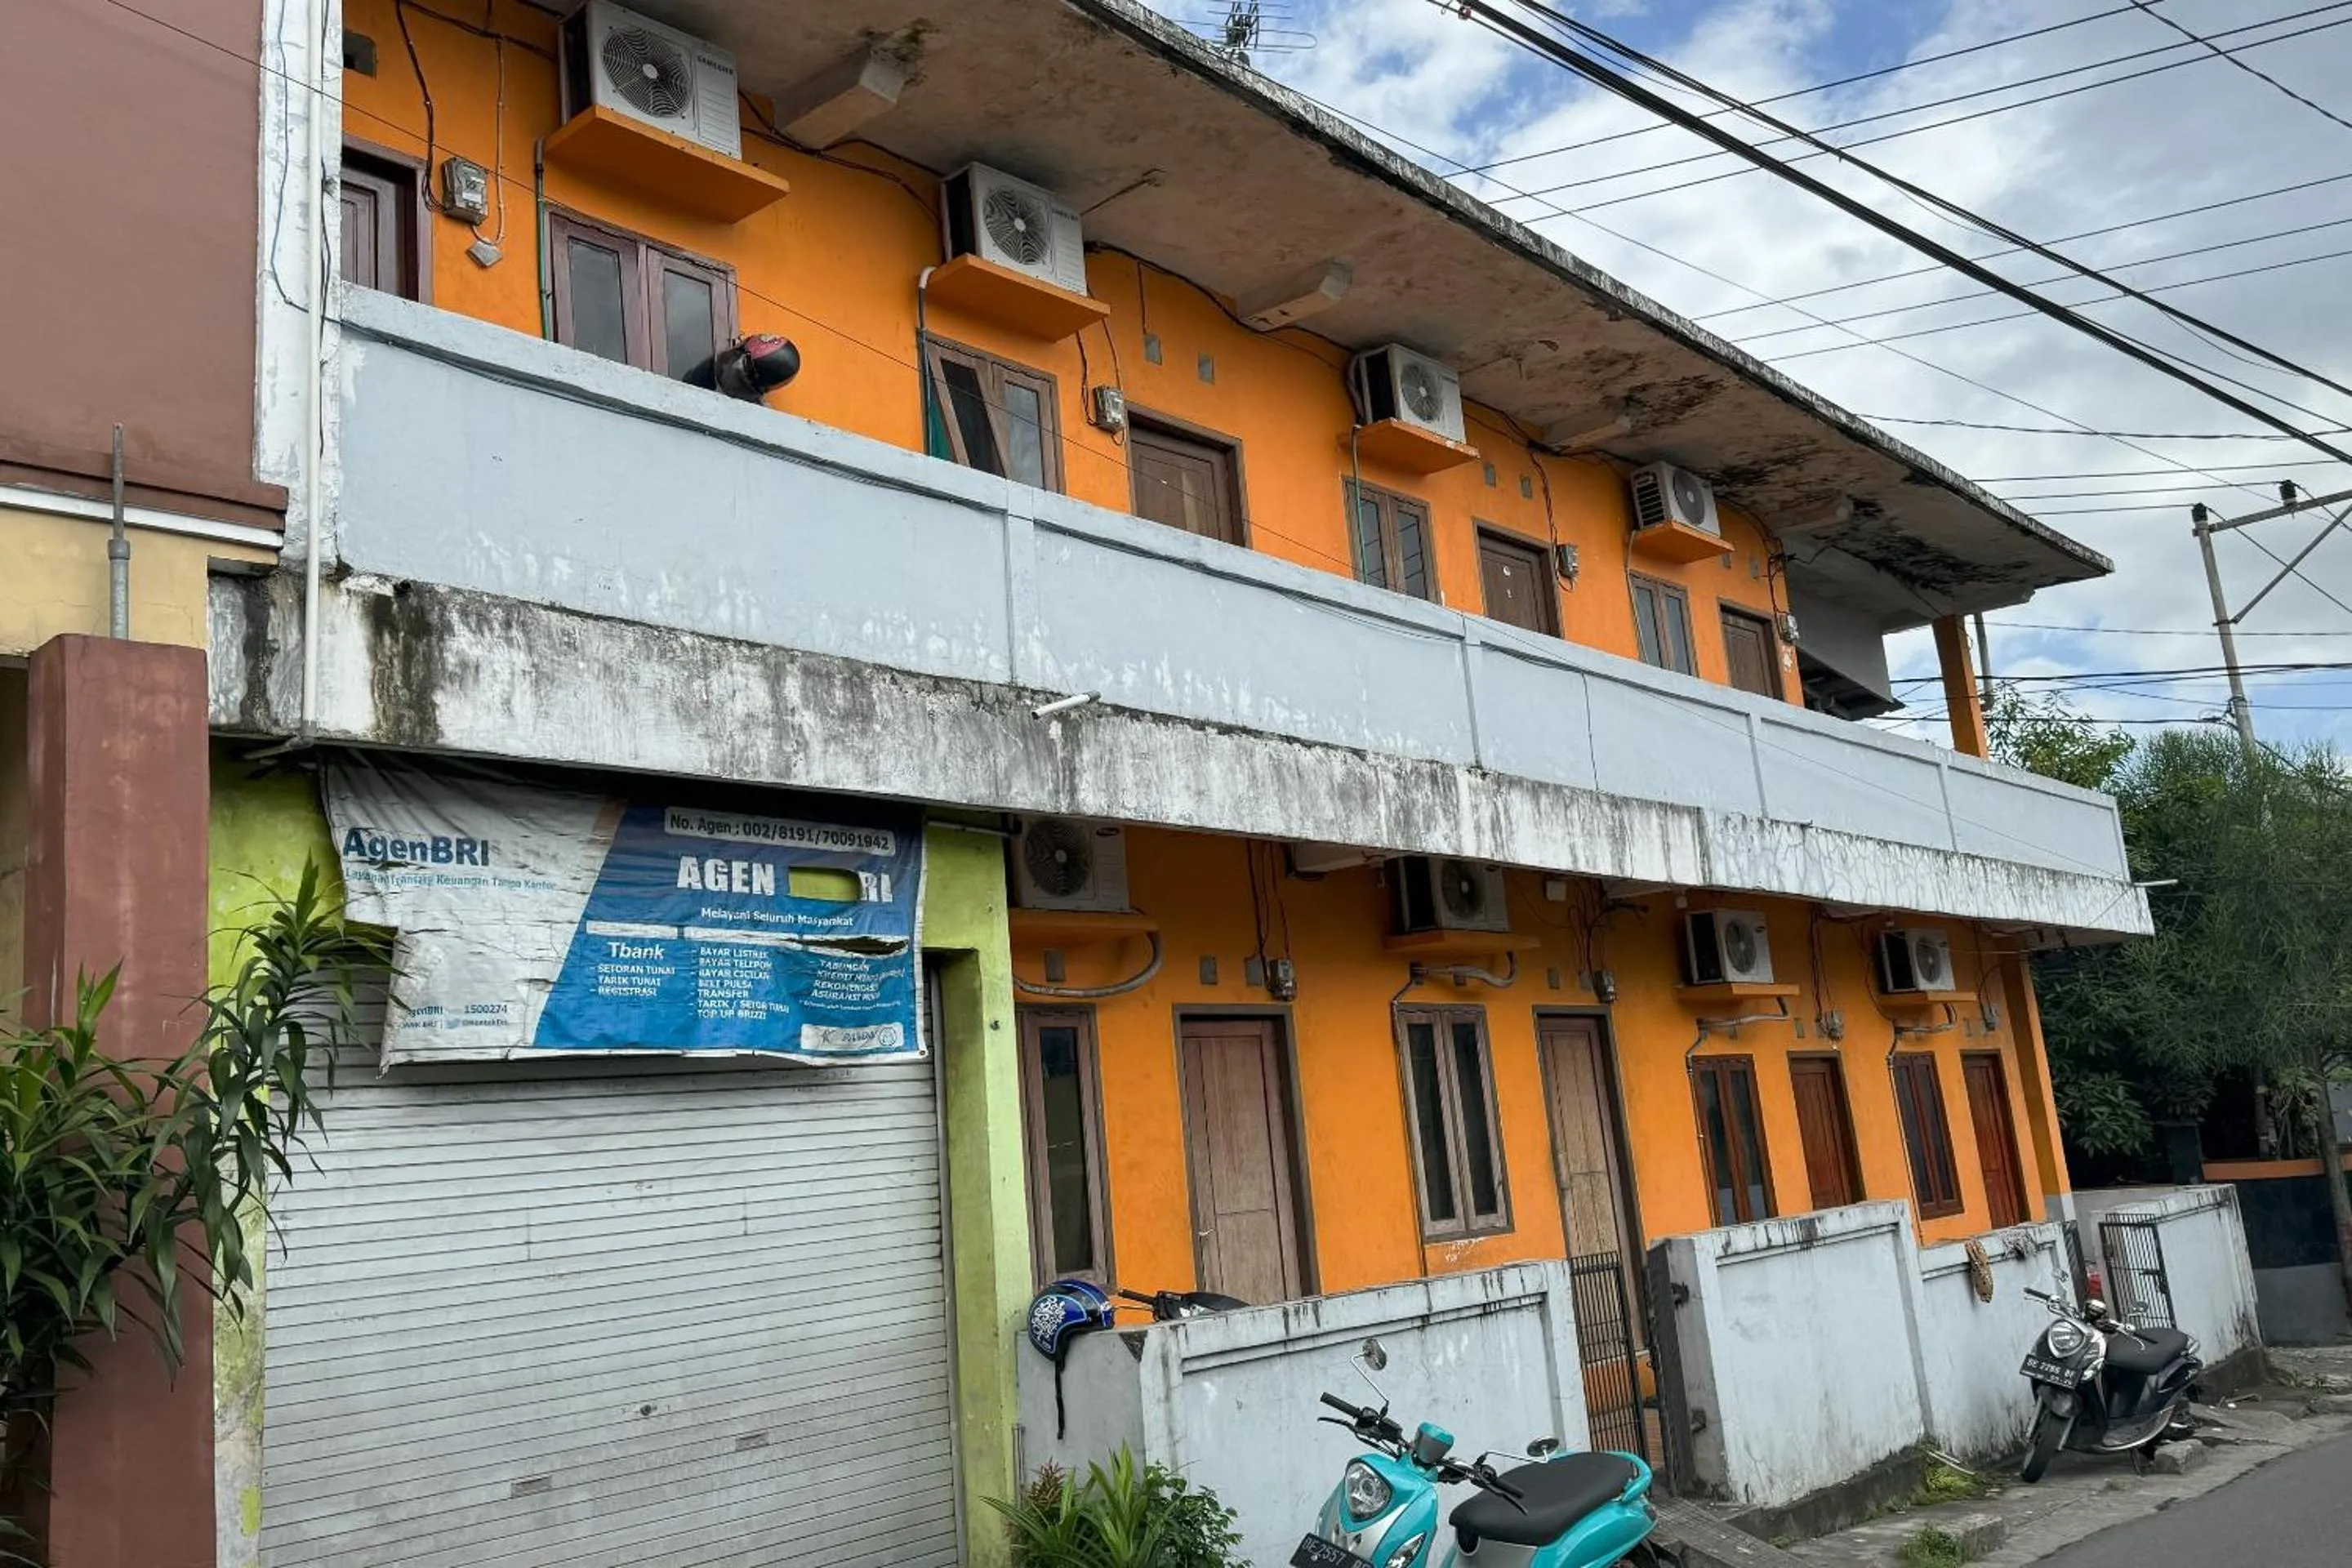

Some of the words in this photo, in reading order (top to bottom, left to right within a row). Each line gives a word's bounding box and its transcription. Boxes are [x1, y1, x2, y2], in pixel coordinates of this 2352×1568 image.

[670, 814, 693, 831] No.
[697, 817, 732, 835] Agen
[342, 826, 490, 867] AgenBRI
[676, 855, 775, 897] AGEN
[858, 871, 893, 903] RI
[701, 907, 751, 922] Melayani
[753, 910, 795, 925] Seluruh
[797, 914, 853, 927] Masyarakat
[607, 942, 666, 960] Tbank
[700, 947, 730, 957] BAYAR
[699, 957, 731, 968] BAYAR
[598, 964, 644, 974] SETORAN
[699, 969, 732, 978] BAYAR
[598, 975, 629, 985] TARIK
[598, 986, 657, 996] REGISTRASI
[697, 989, 750, 998] TRANSFER
[697, 1009, 718, 1019] TOP
[720, 1009, 734, 1018] UP
